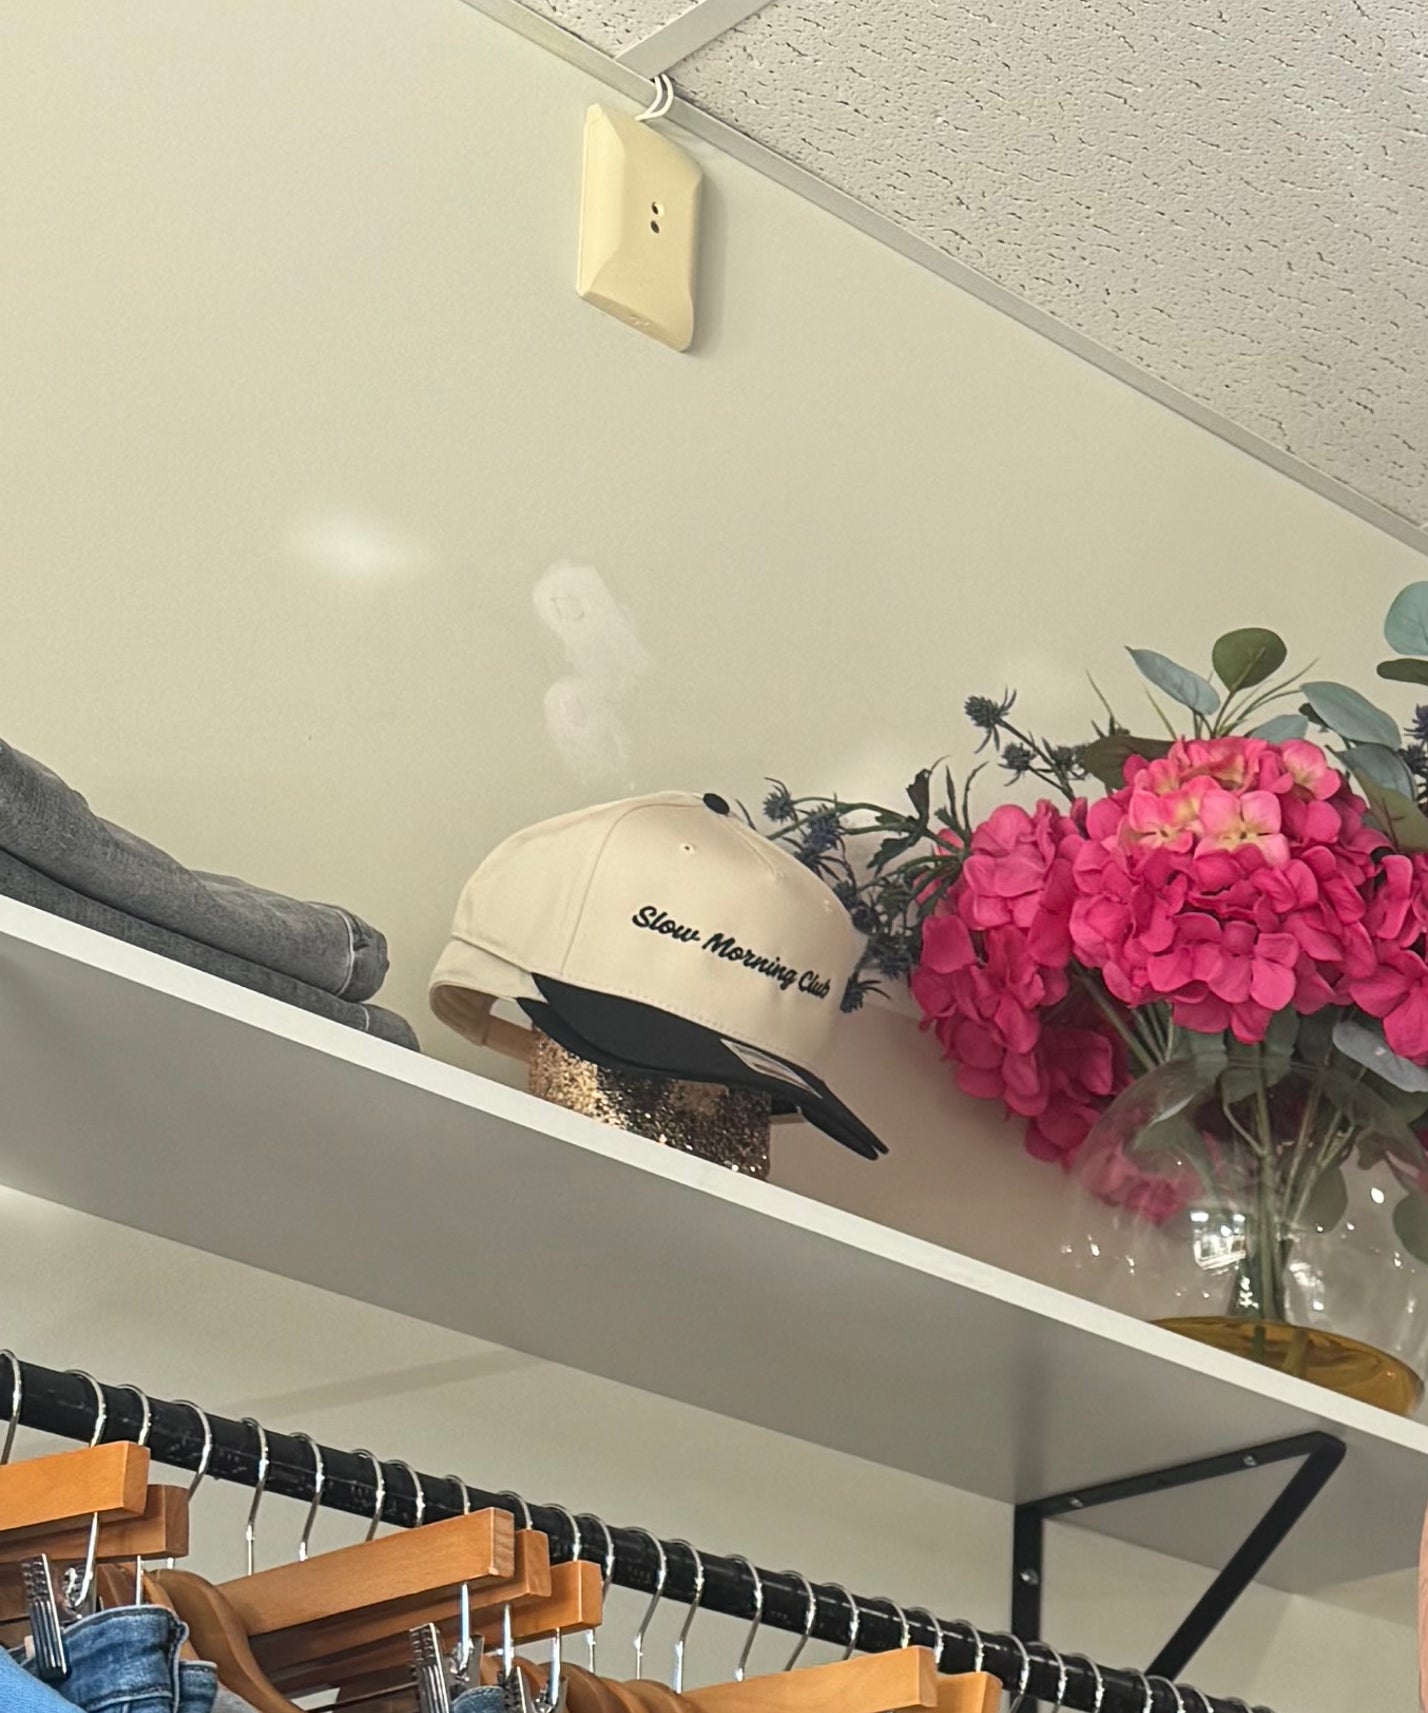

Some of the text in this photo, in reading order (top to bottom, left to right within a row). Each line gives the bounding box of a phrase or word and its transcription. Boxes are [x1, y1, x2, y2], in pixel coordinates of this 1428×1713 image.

[632, 905, 832, 1000] Slow Morning Club
